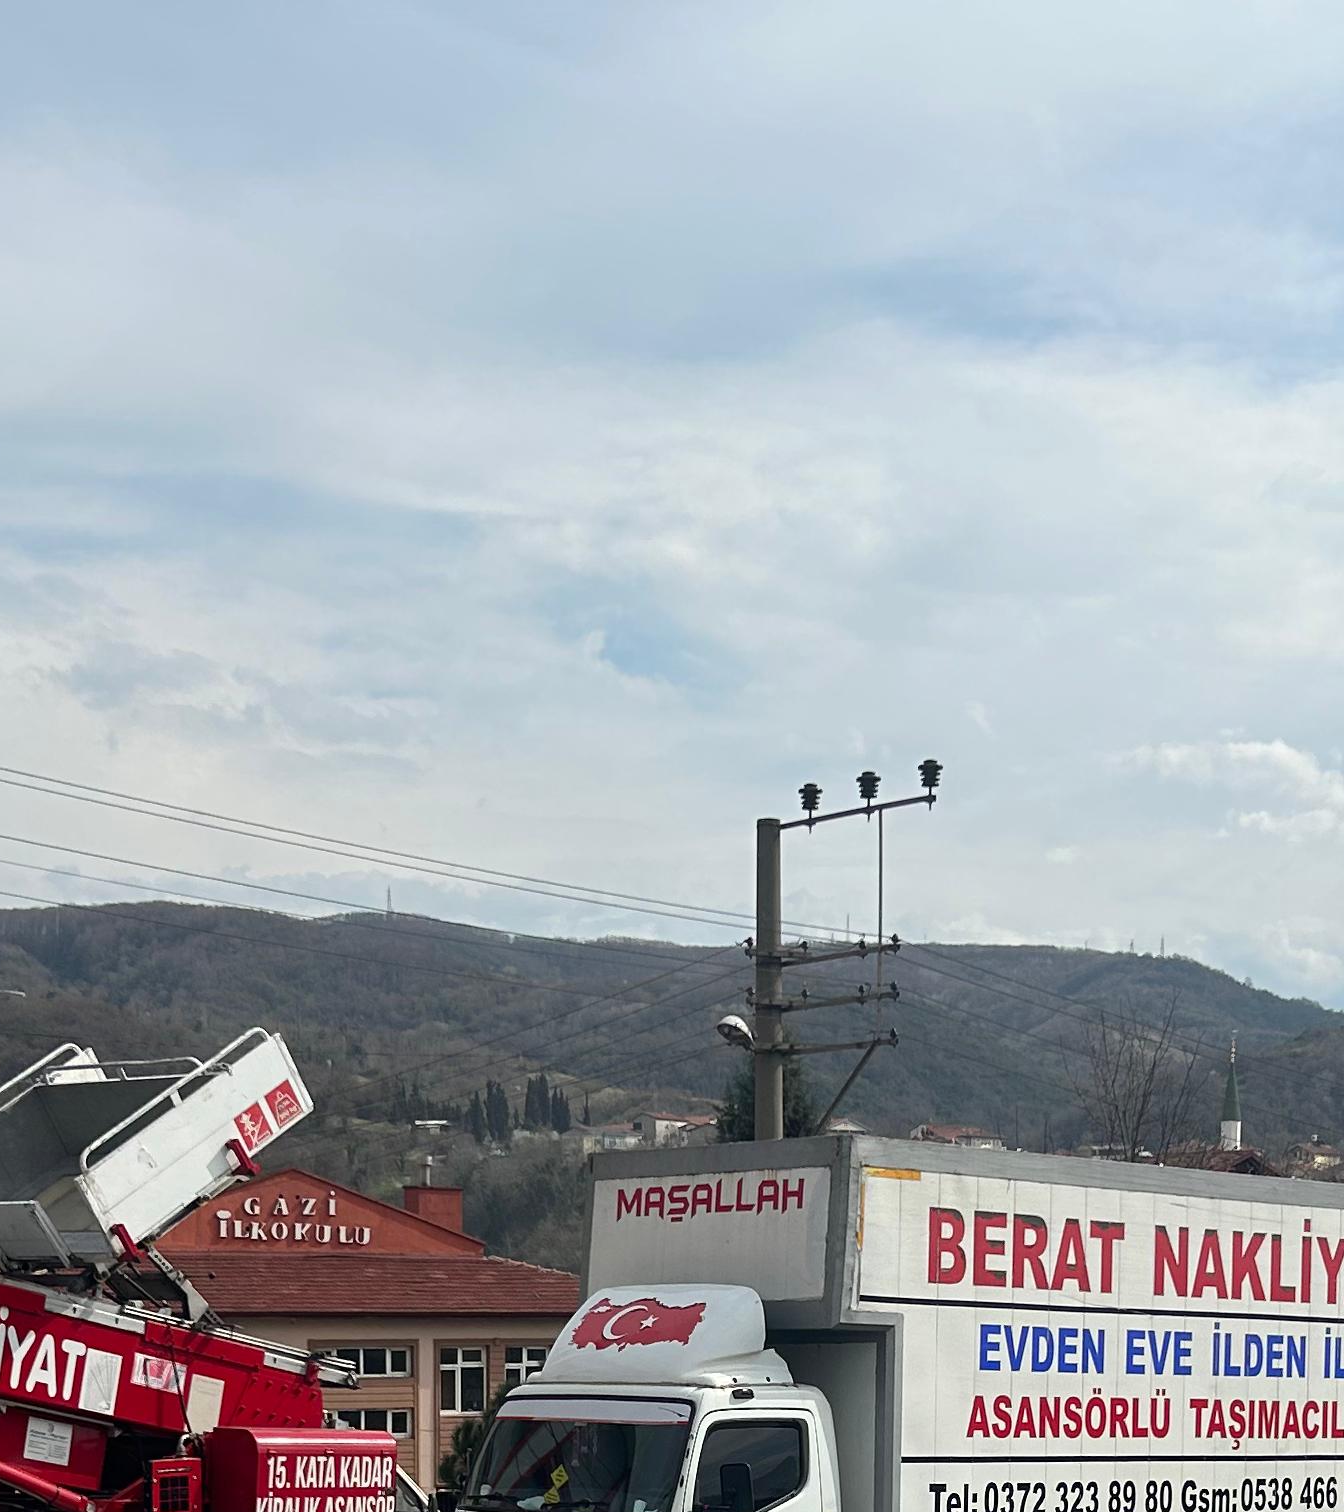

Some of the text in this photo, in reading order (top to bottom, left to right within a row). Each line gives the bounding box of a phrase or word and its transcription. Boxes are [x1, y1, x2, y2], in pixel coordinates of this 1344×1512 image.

[244, 1190, 338, 1217] GAZİ
[616, 1177, 805, 1222] MAŞALLAH
[216, 1211, 372, 1246] İLKOKULU
[928, 1206, 1125, 1293] BERAT
[979, 1324, 1105, 1374] EVDEN
[1125, 1329, 1193, 1376] EVE
[1212, 1321, 1307, 1379] İLDEN
[966, 1388, 1171, 1439] ASANSÖRLÜ
[267, 1456, 393, 1488] 15. KATA KADAR
[1240, 1477, 1292, 1512] 0538
[1299, 1476, 1338, 1511] 466
